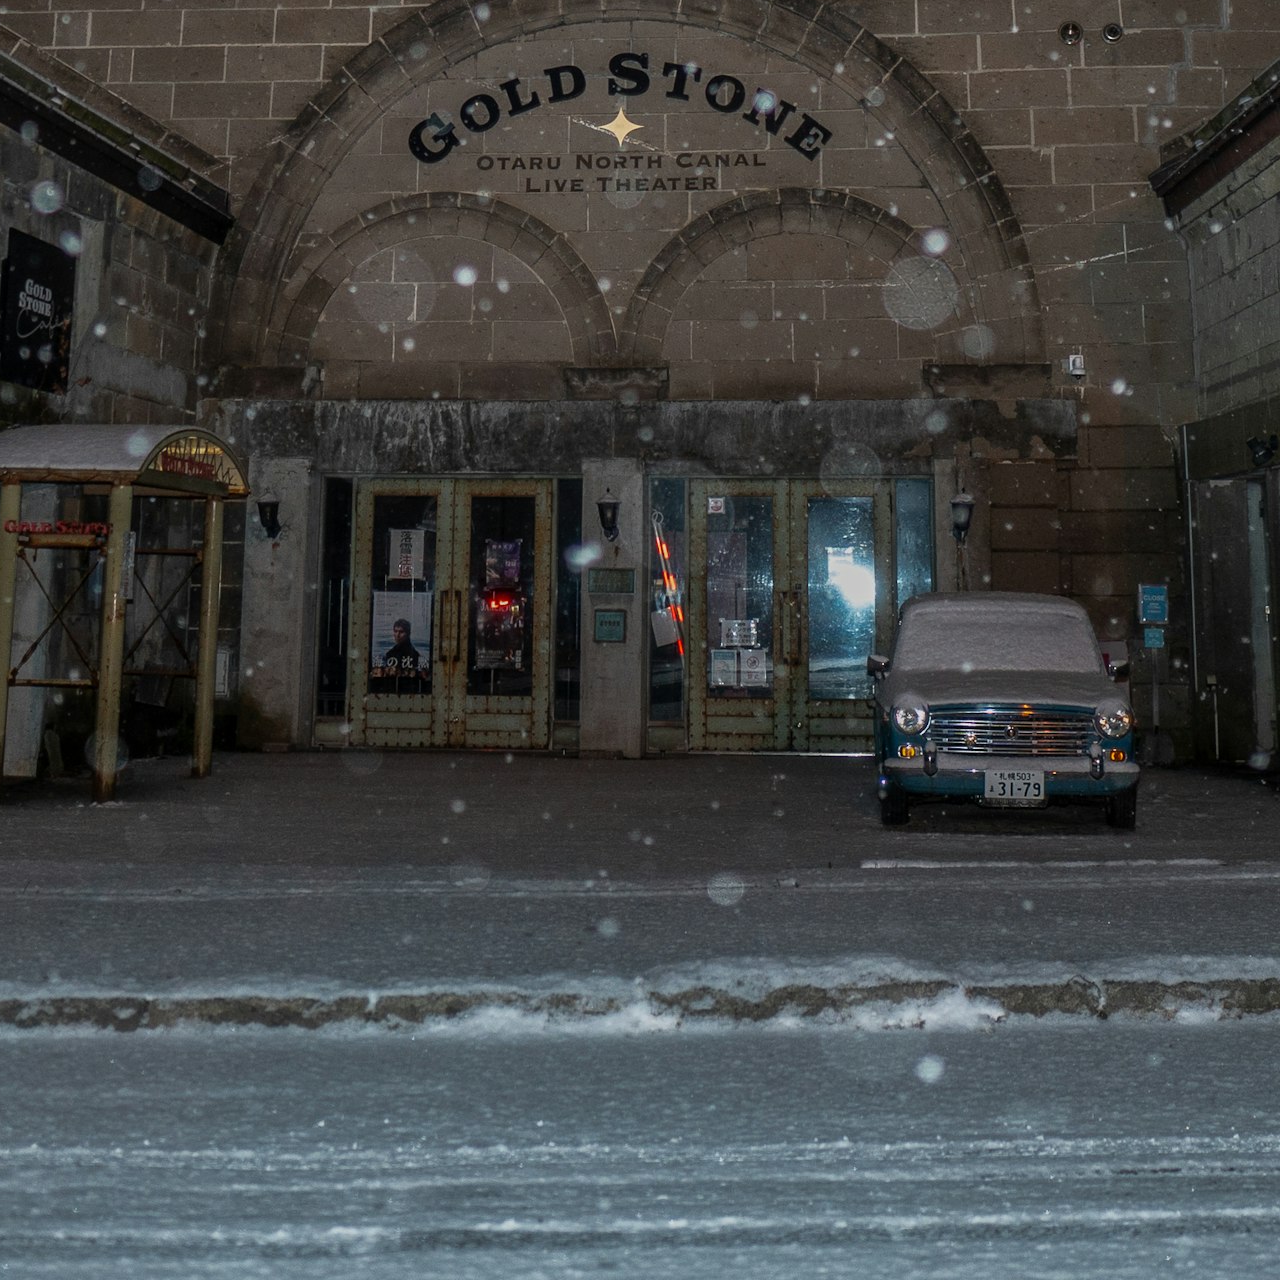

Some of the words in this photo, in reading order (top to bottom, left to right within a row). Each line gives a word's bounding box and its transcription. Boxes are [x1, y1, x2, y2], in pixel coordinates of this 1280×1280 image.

[407, 64, 587, 164] GOLD
[608, 52, 833, 162] STONE
[476, 154, 562, 170] OTARU
[576, 153, 662, 170] NORTH
[675, 152, 767, 169] CANAL
[525, 177, 585, 193] LIVE
[596, 176, 717, 192] THEATER
[25, 278, 53, 301] GOLD
[18, 291, 52, 317] STONE
[998, 782, 1041, 797] 31-79
